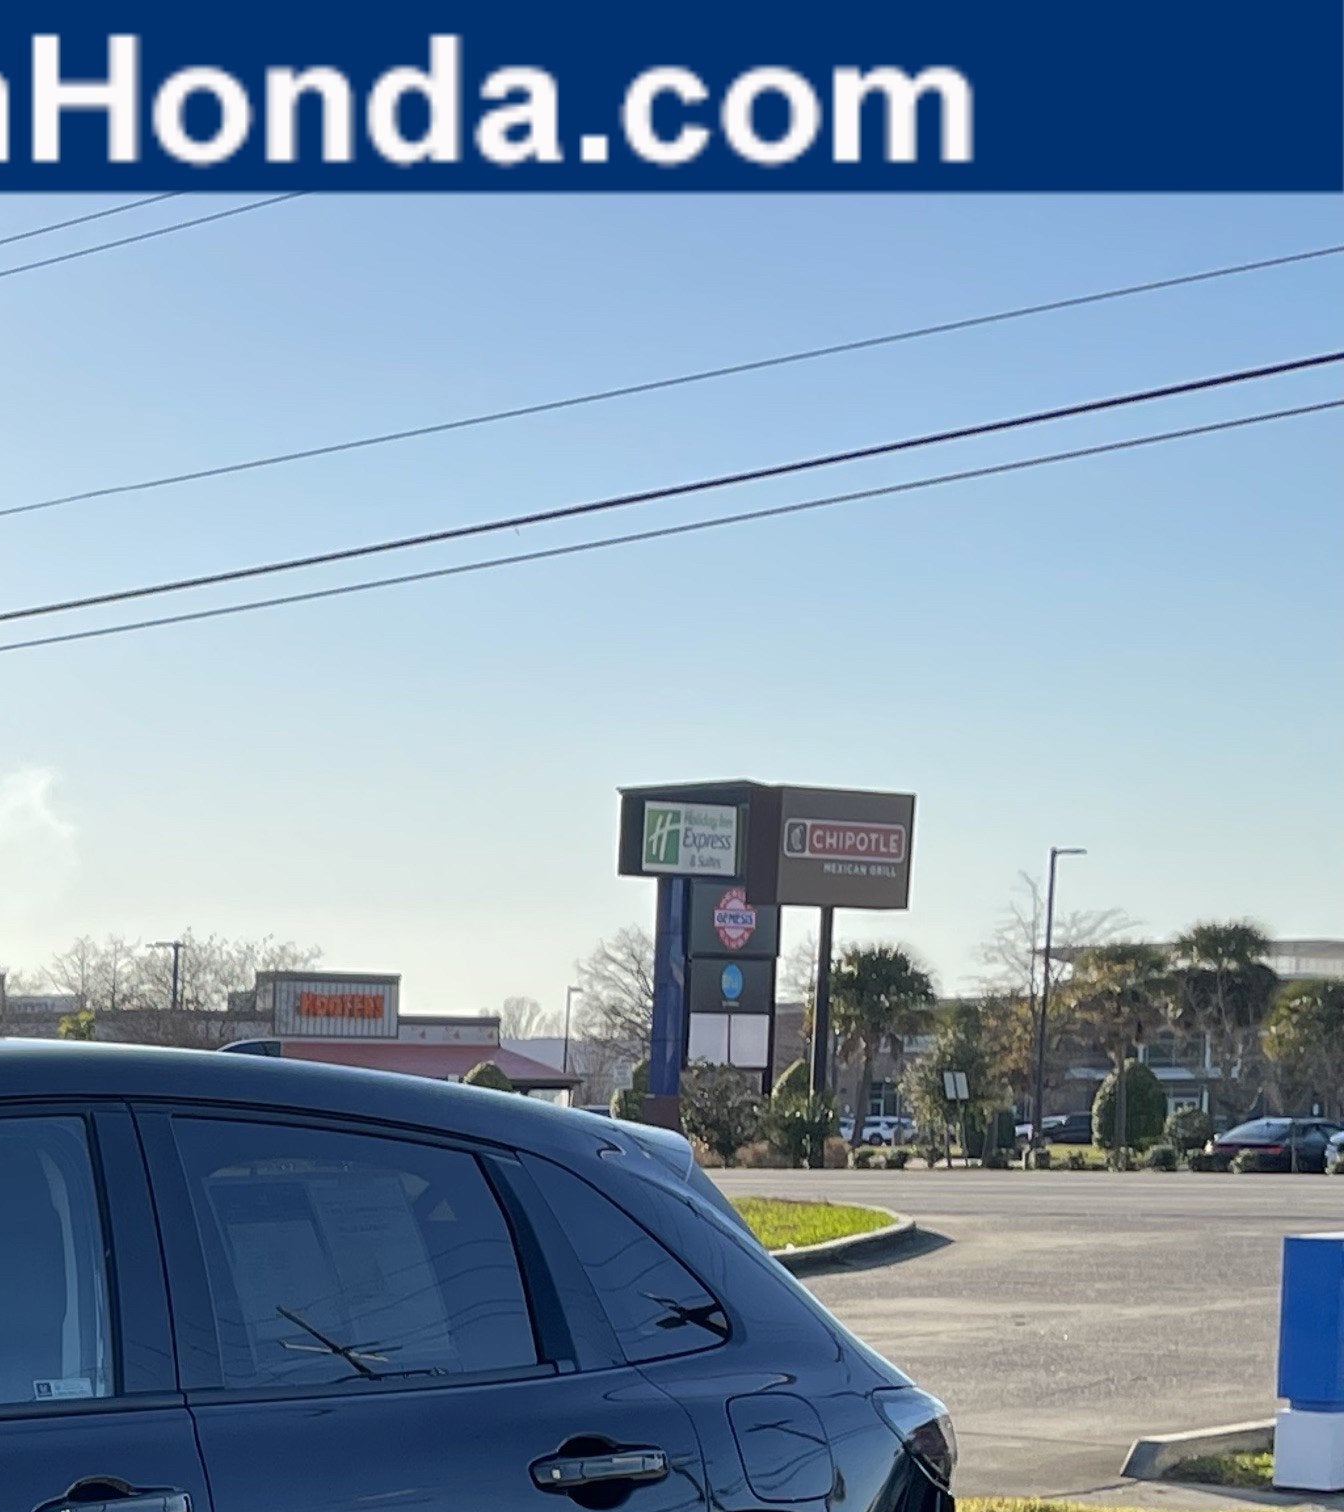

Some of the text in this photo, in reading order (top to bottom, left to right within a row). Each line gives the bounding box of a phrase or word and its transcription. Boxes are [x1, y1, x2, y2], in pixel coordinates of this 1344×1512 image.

[683, 827, 732, 852] Express
[812, 828, 900, 853] CHIPOTLE
[823, 863, 896, 878] MEXICAN GRILL
